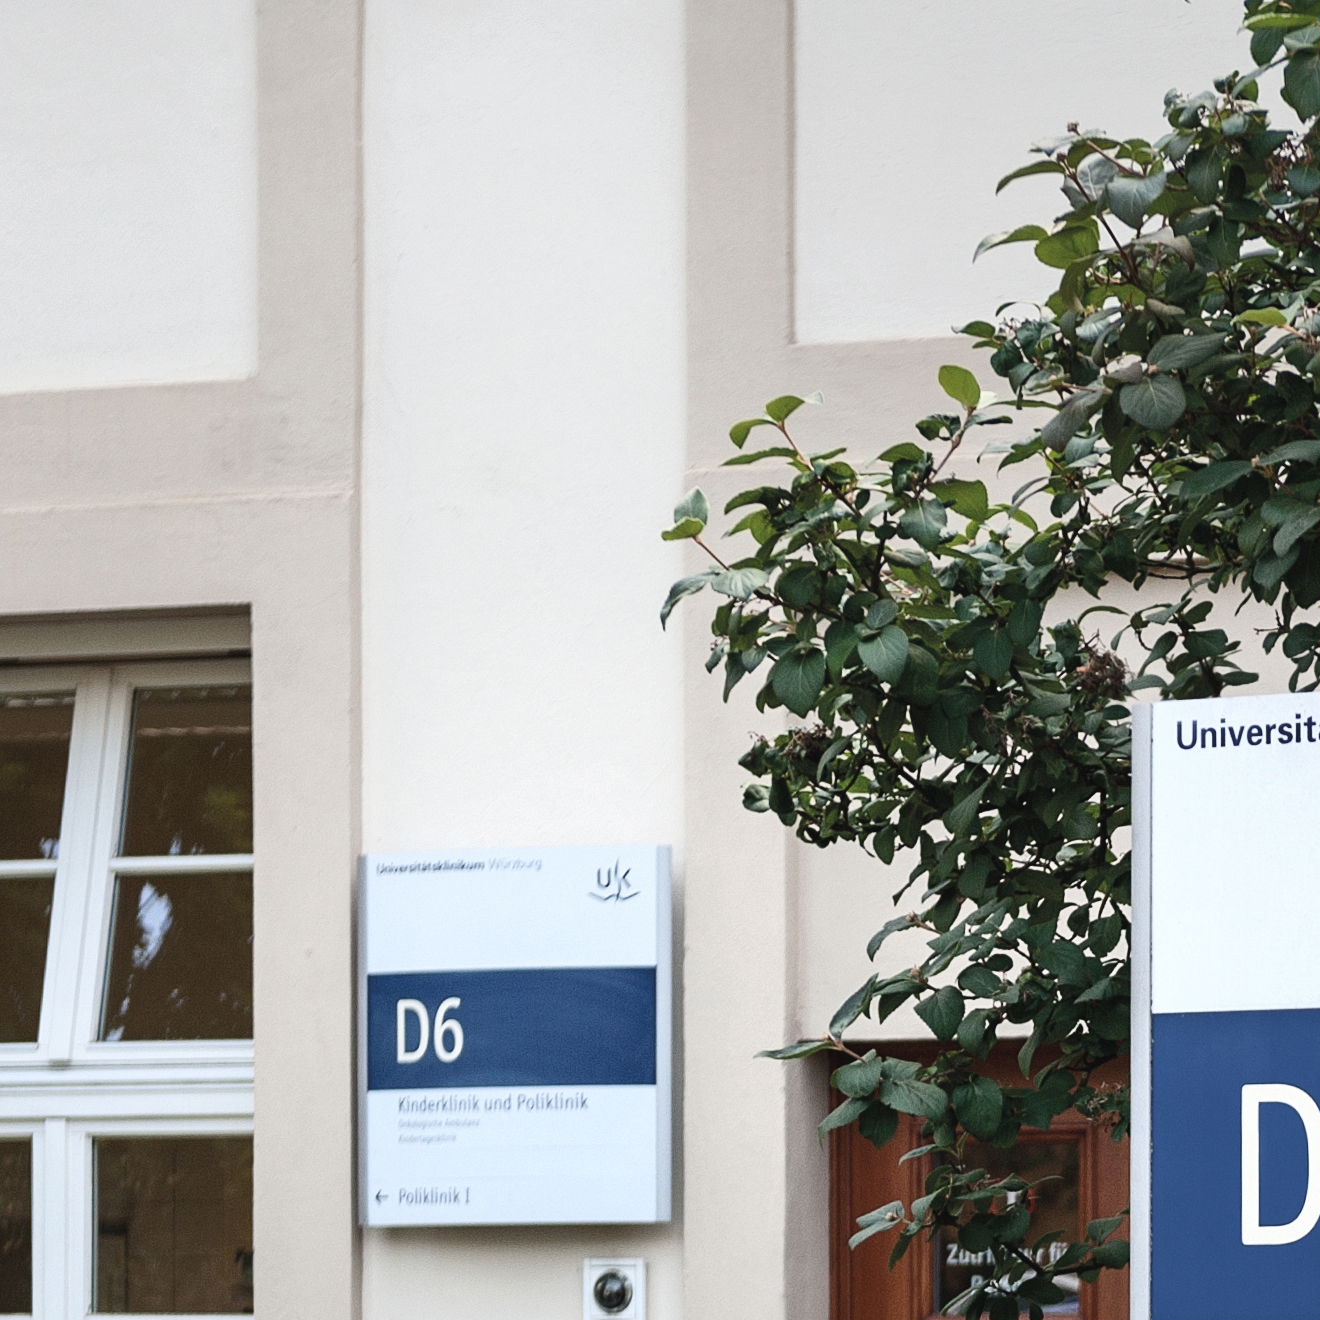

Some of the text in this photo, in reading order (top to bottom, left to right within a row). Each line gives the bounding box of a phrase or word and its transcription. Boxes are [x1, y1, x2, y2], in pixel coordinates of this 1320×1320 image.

[396, 996, 464, 1064] D6
[398, 1091, 590, 1113] Kinderklinik und Poliklinik
[398, 1186, 461, 1204] Poliklinik
